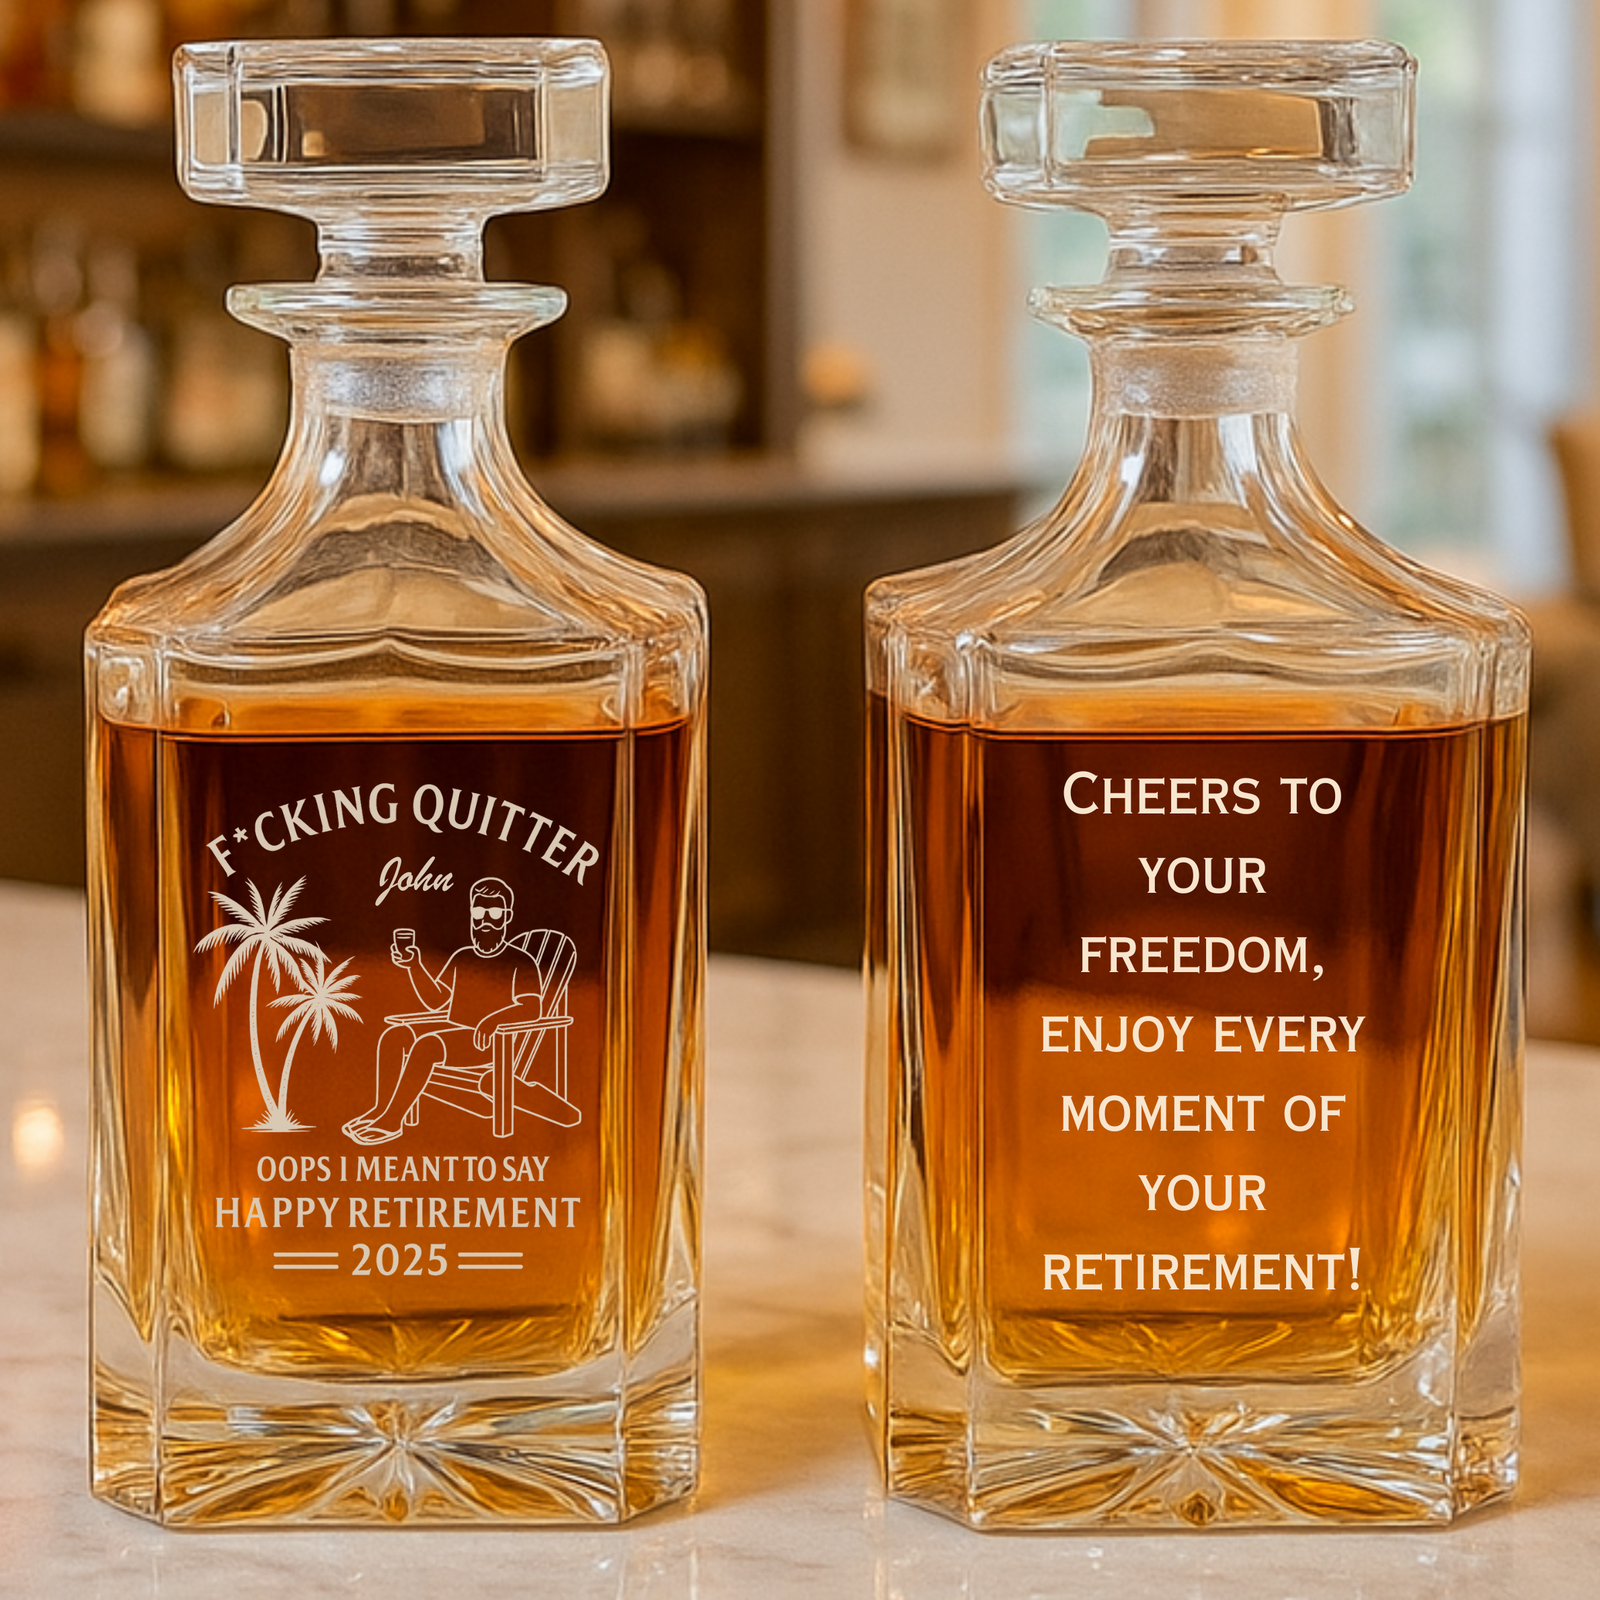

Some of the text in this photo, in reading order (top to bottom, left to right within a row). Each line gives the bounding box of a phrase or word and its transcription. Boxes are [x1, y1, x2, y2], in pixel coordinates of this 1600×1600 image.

[1281, 778, 1341, 814] TO
[413, 784, 599, 885] QUITTER
[375, 857, 453, 906] John
[1139, 857, 1266, 893] YOUR
[1081, 936, 1323, 981] FREEDOM,
[1042, 1016, 1365, 1052] ENJOY EVERY
[1062, 1095, 1345, 1131] MOMENT OF
[258, 1156, 549, 1181] OOPS I MEANT TO SAY
[1139, 1175, 1266, 1211] YOUR
[216, 1198, 580, 1227] HAPPY RETIREMENT
[352, 1244, 447, 1275] 2025
[1044, 1248, 1360, 1290] RETIREMENT!
